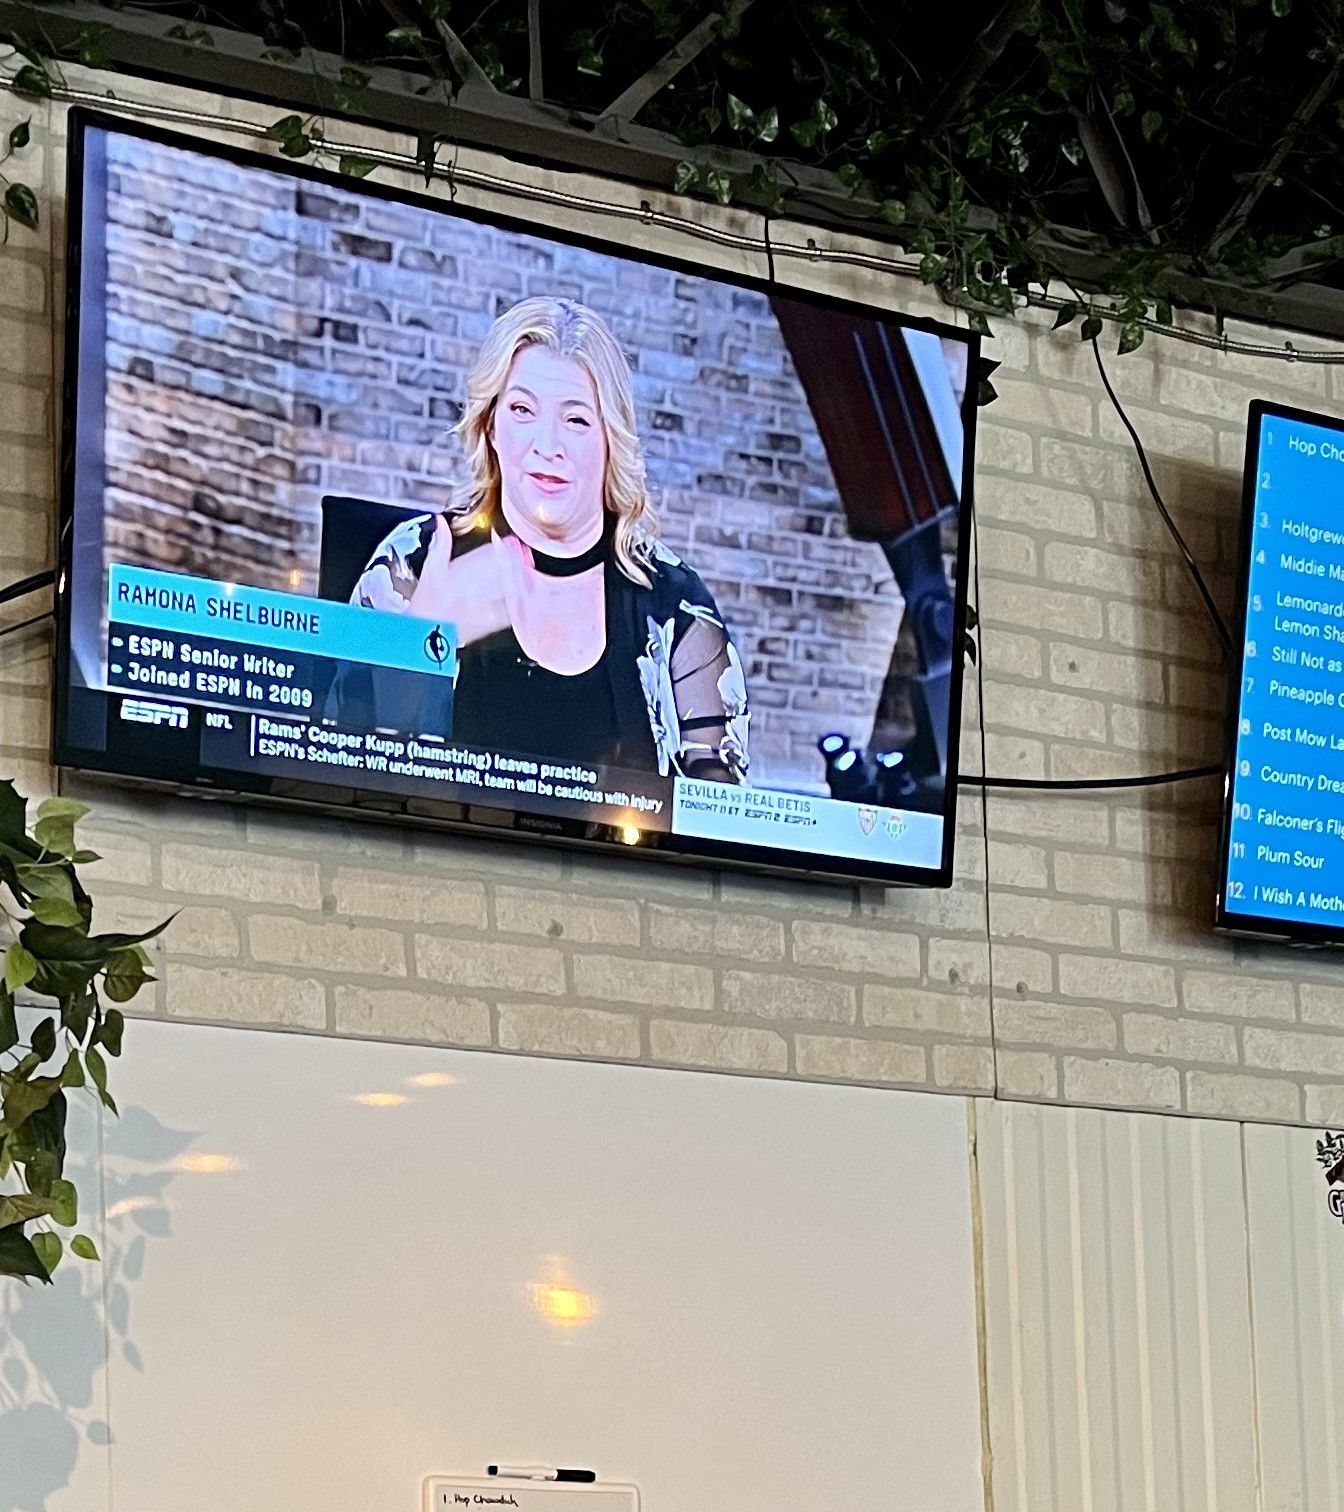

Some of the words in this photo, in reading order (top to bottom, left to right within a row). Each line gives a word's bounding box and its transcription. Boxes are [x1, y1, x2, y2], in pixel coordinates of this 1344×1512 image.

[1289, 436, 1316, 456] Hop
[118, 583, 197, 614] RAMONA
[207, 598, 320, 634] SHELBURNE
[128, 635, 174, 659] ESPN
[180, 644, 238, 669] Senior
[244, 653, 294, 679] Writer
[128, 662, 190, 688] Joined
[196, 673, 240, 696] ESPN
[246, 680, 263, 700] in
[269, 684, 313, 707] 2009
[1269, 679, 1335, 706] Pineapple
[120, 699, 188, 728] ESPN
[206, 712, 233, 729] NFL
[1263, 723, 1292, 742] Post
[1295, 728, 1327, 746] Mow
[259, 718, 305, 739] Rams'
[308, 726, 363, 749] Cooper
[366, 735, 404, 757] Kupp
[407, 741, 492, 770] (hamstring)
[494, 754, 538, 774] leaves
[541, 764, 597, 784] practice
[259, 739, 305, 760] ESPN's
[308, 746, 364, 768] Schefter:
[366, 756, 387, 771] WR
[389, 762, 454, 782] underwent
[455, 768, 483, 786] MRI,
[484, 773, 515, 790] team
[517, 779, 536, 793] will
[538, 780, 552, 796] be
[555, 786, 603, 803] cautious
[605, 792, 629, 806] with
[630, 794, 662, 814] injury
[1261, 766, 1314, 789] Country
[680, 783, 728, 800] SEVILLA
[745, 793, 774, 808] REAL
[1258, 808, 1323, 833] Falconer's
[1258, 846, 1290, 864] Plum
[1294, 852, 1324, 869] Sour
[1262, 886, 1293, 905] Wish
[1297, 891, 1306, 906] A
